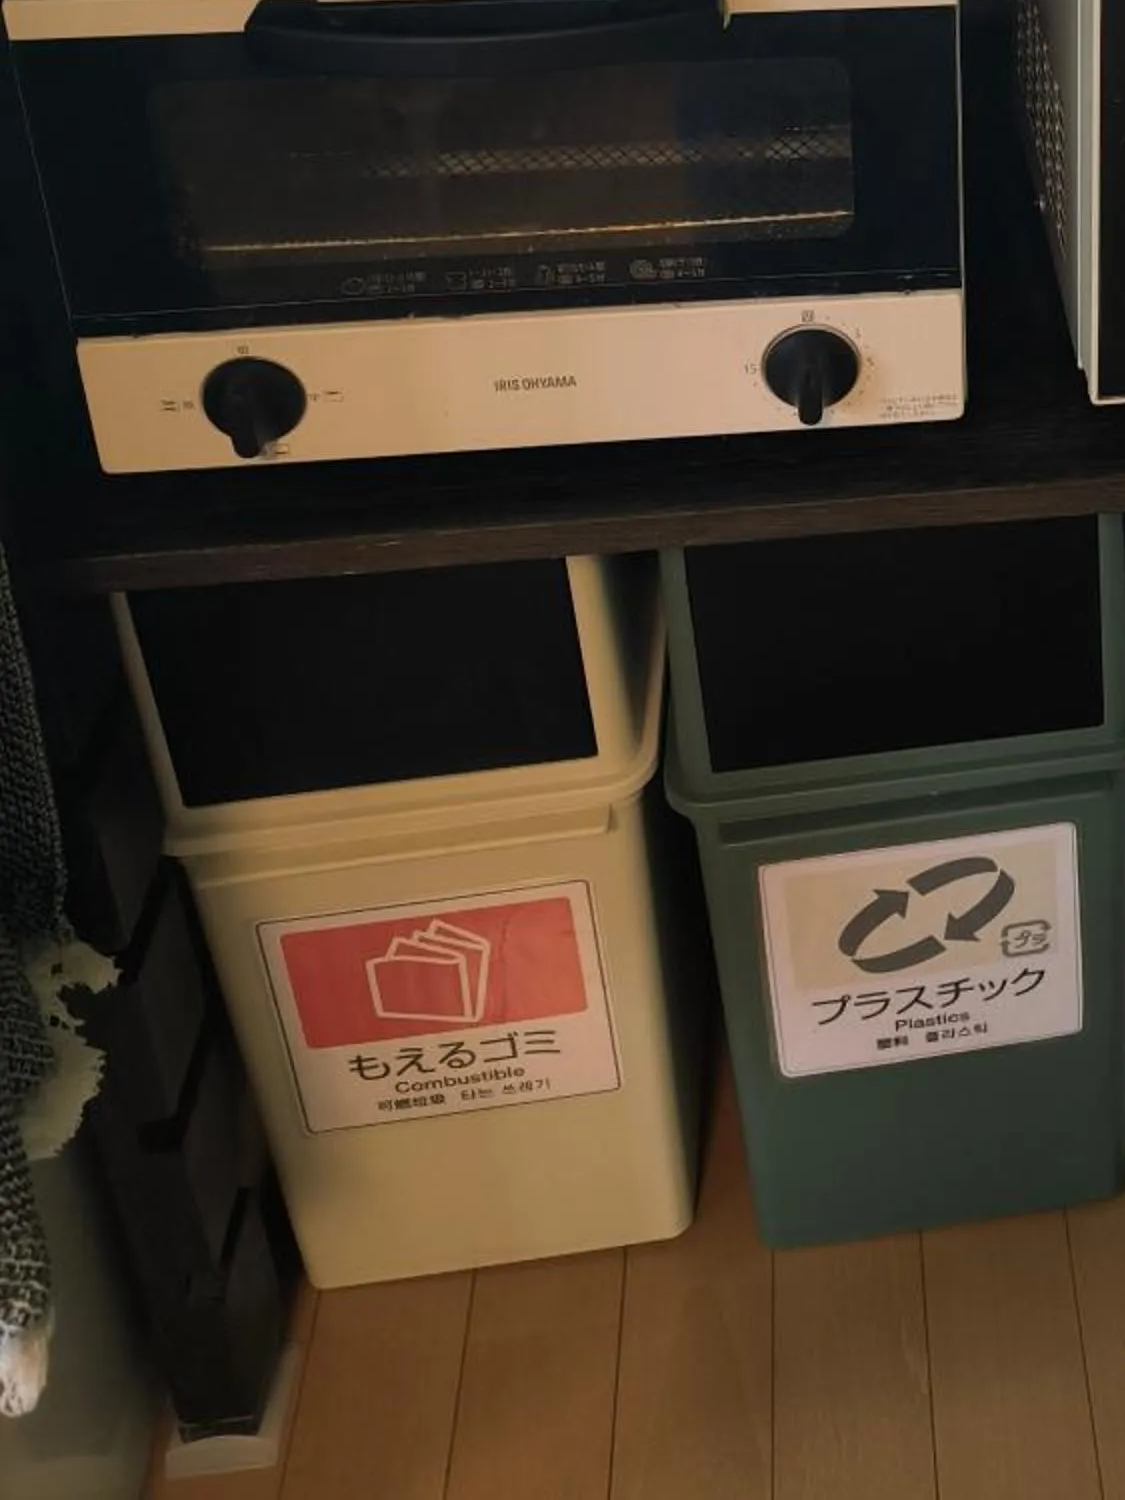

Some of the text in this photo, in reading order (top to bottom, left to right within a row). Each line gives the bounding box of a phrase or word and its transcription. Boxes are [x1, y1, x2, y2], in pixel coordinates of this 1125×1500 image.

[494, 375, 577, 391] IRIS OHYAMA
[1013, 929, 1048, 949] プラ
[811, 967, 1046, 1026] プラスチック
[895, 1011, 971, 1032] Plastics
[349, 1029, 561, 1081] もえるゴミ
[395, 1065, 526, 1094] Combustible
